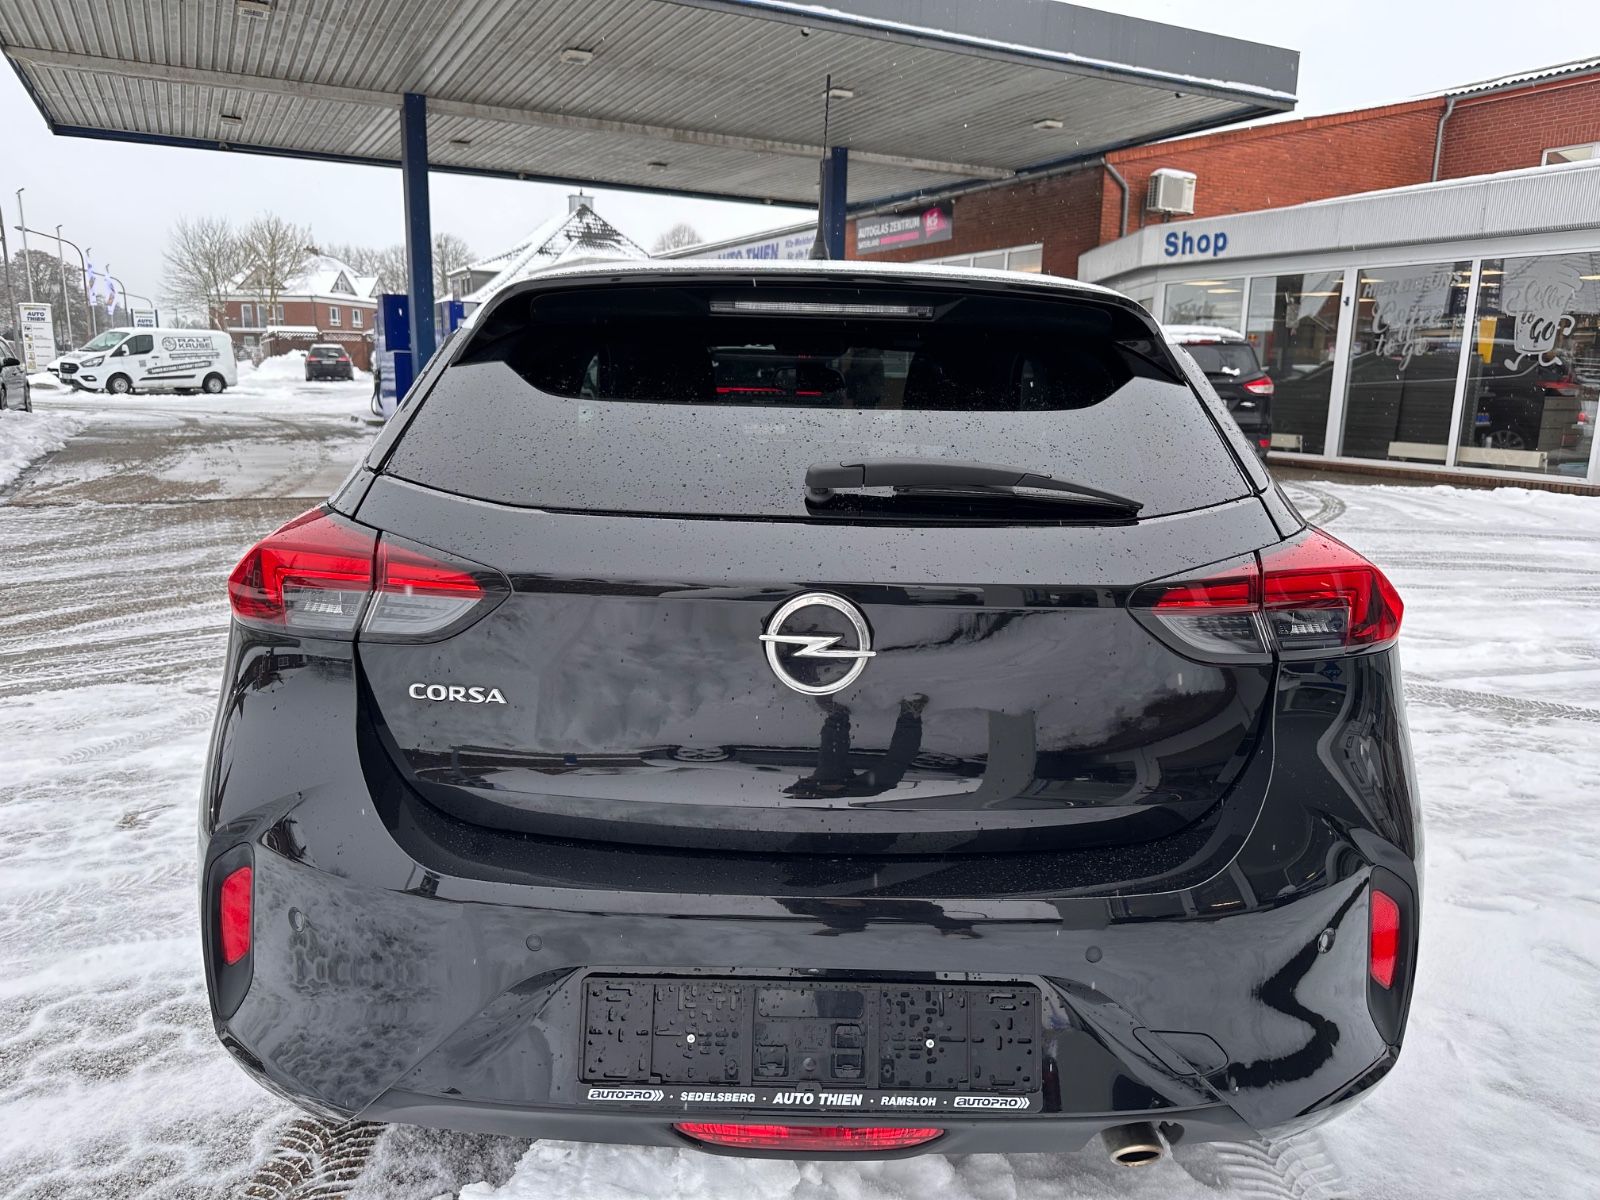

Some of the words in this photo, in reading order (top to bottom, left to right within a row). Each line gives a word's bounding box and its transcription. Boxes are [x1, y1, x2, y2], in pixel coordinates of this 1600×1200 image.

[1164, 231, 1227, 257] Shop
[408, 682, 507, 704] CORSA
[680, 1091, 756, 1103] SEDELSBERG
[772, 1092, 814, 1105] AUTO
[818, 1093, 863, 1106] THIEN
[880, 1095, 937, 1107] RAMSLOH
